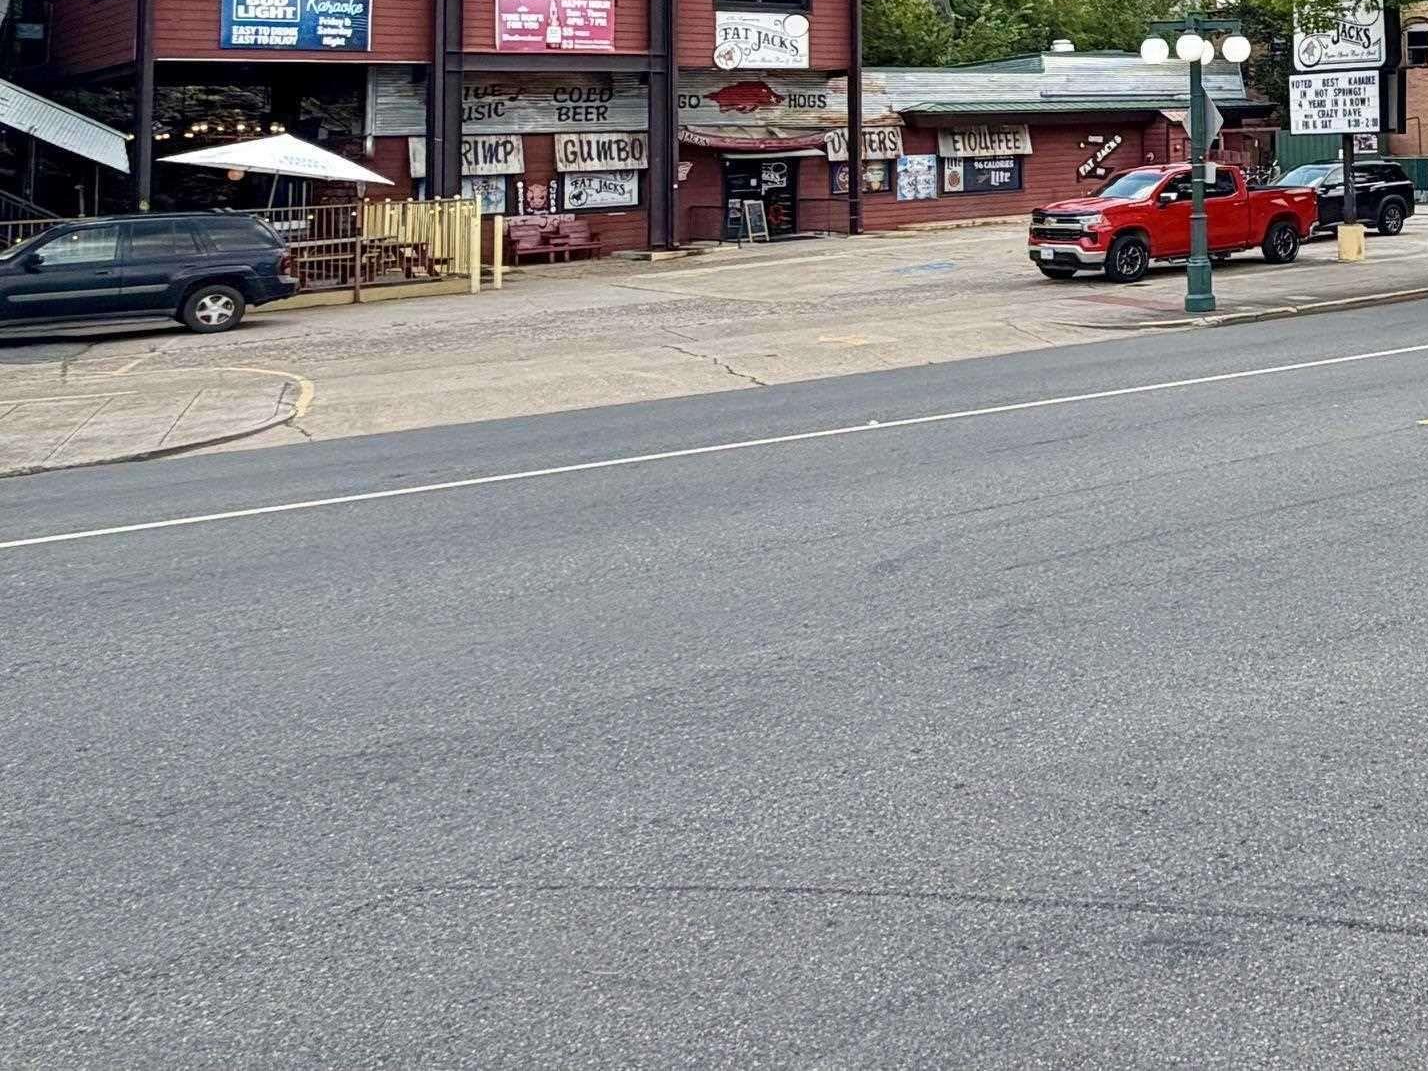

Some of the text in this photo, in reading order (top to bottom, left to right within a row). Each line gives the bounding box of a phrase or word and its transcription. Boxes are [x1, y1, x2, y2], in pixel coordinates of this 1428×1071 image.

[237, 5, 297, 19] LIGHT
[232, 25, 255, 35] EASY
[258, 26, 270, 35] TO
[319, 16, 344, 28] Friday
[231, 34, 255, 44] EASY
[257, 35, 270, 44] TO
[317, 25, 353, 38] Saturday
[1331, 22, 1371, 49] JACKS
[722, 27, 799, 57] FAT JACKS
[1291, 79, 1313, 89] VOTED
[1322, 77, 1339, 87] BEST
[463, 83, 500, 100] IVE
[553, 86, 615, 103] COLD
[1315, 88, 1329, 98] HOT
[678, 94, 827, 109] GO HOGS
[1308, 99, 1327, 108] YEARS
[462, 102, 505, 123] USIC
[556, 105, 609, 122] BEER
[1317, 109, 1339, 118] CRAZY
[1342, 108, 1362, 117] DAVE
[831, 129, 898, 154] OYTERS
[953, 129, 1021, 152] ETOUFFEE
[462, 139, 515, 167] RIMP
[563, 137, 645, 165] GUMBO
[1079, 135, 1122, 176] FAT JACKS
[974, 160, 1014, 169] 96 CALORIES
[990, 170, 1011, 186] Lite
[571, 178, 626, 196] FAT JACKS
